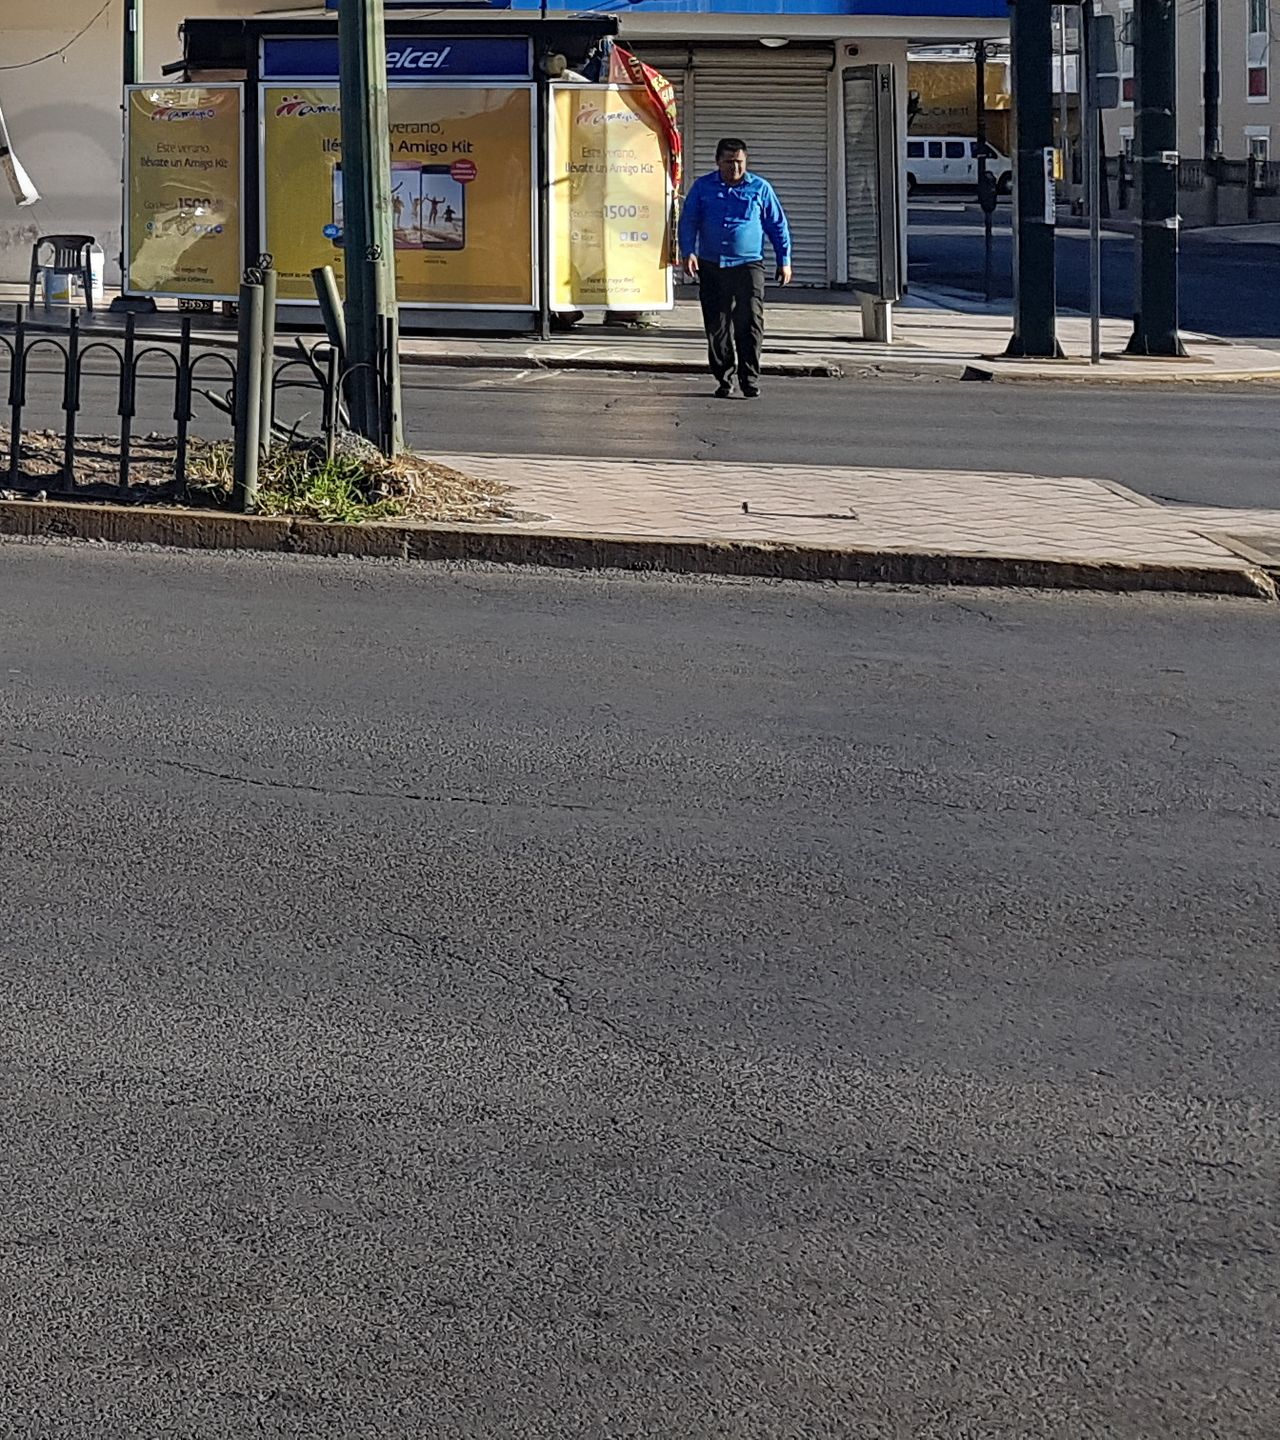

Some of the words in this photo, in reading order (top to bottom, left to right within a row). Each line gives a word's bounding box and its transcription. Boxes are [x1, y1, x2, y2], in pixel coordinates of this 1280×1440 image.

[386, 46, 452, 69] elcel
[398, 140, 448, 157] Amigo
[452, 140, 473, 154] Kit
[610, 164, 639, 176] Amigo
[640, 163, 654, 174] Kit
[603, 205, 637, 219] 1500
